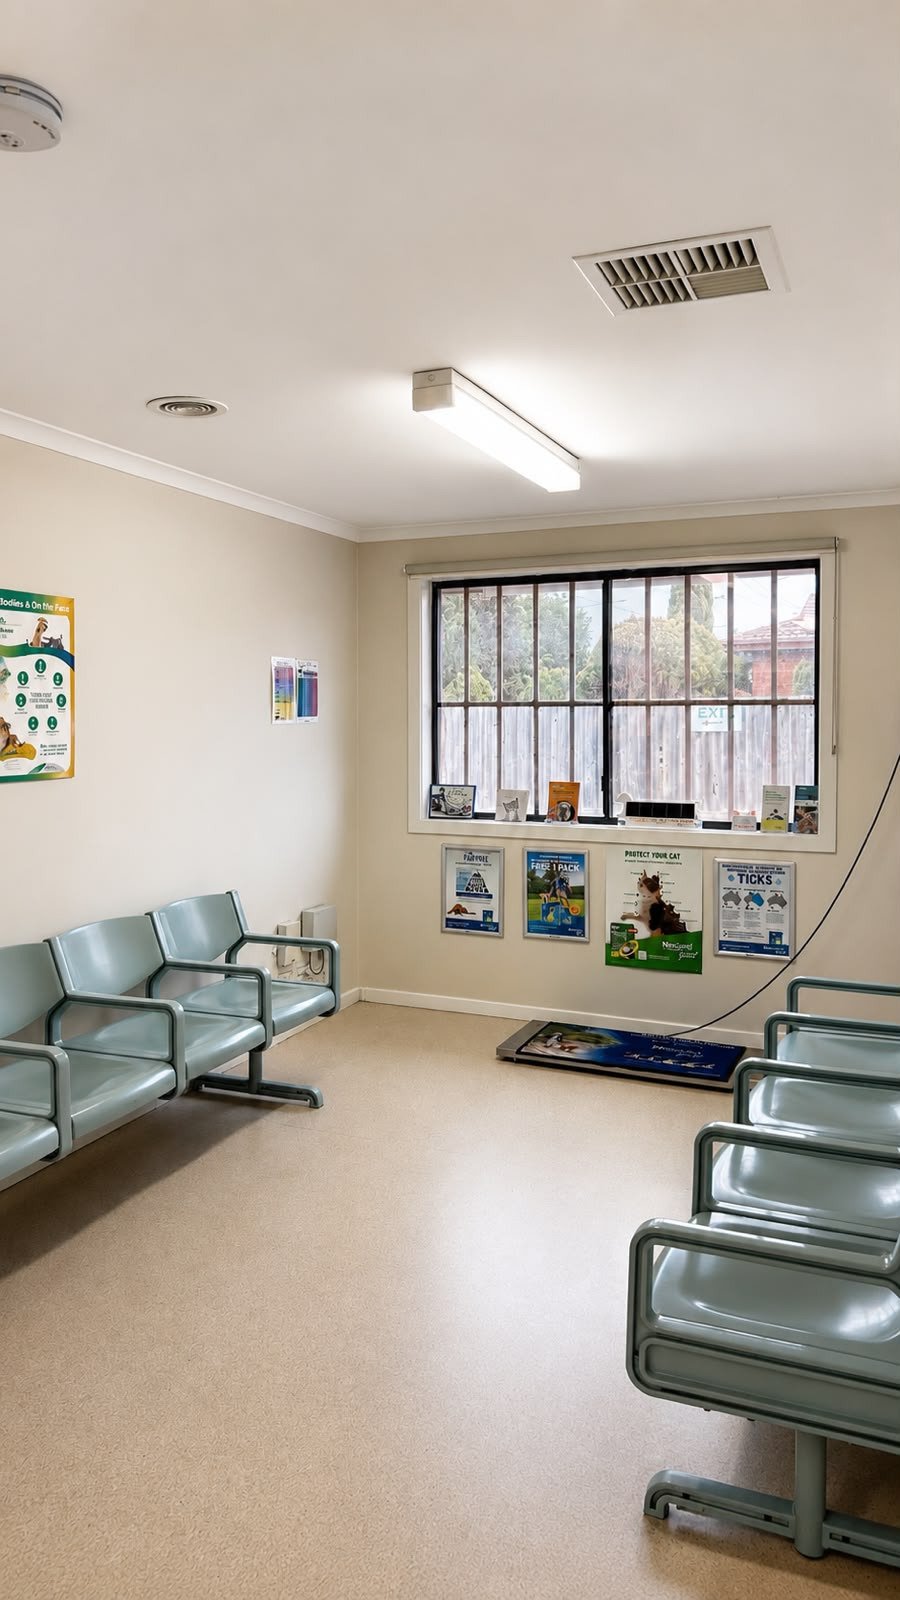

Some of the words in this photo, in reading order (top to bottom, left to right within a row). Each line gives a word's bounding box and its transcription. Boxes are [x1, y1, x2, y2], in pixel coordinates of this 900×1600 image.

[31, 601, 42, 610] On
[624, 850, 650, 858] PROTECT
[669, 852, 681, 860] CAT
[558, 863, 580, 872] PACK
[737, 873, 773, 885] TICKS
